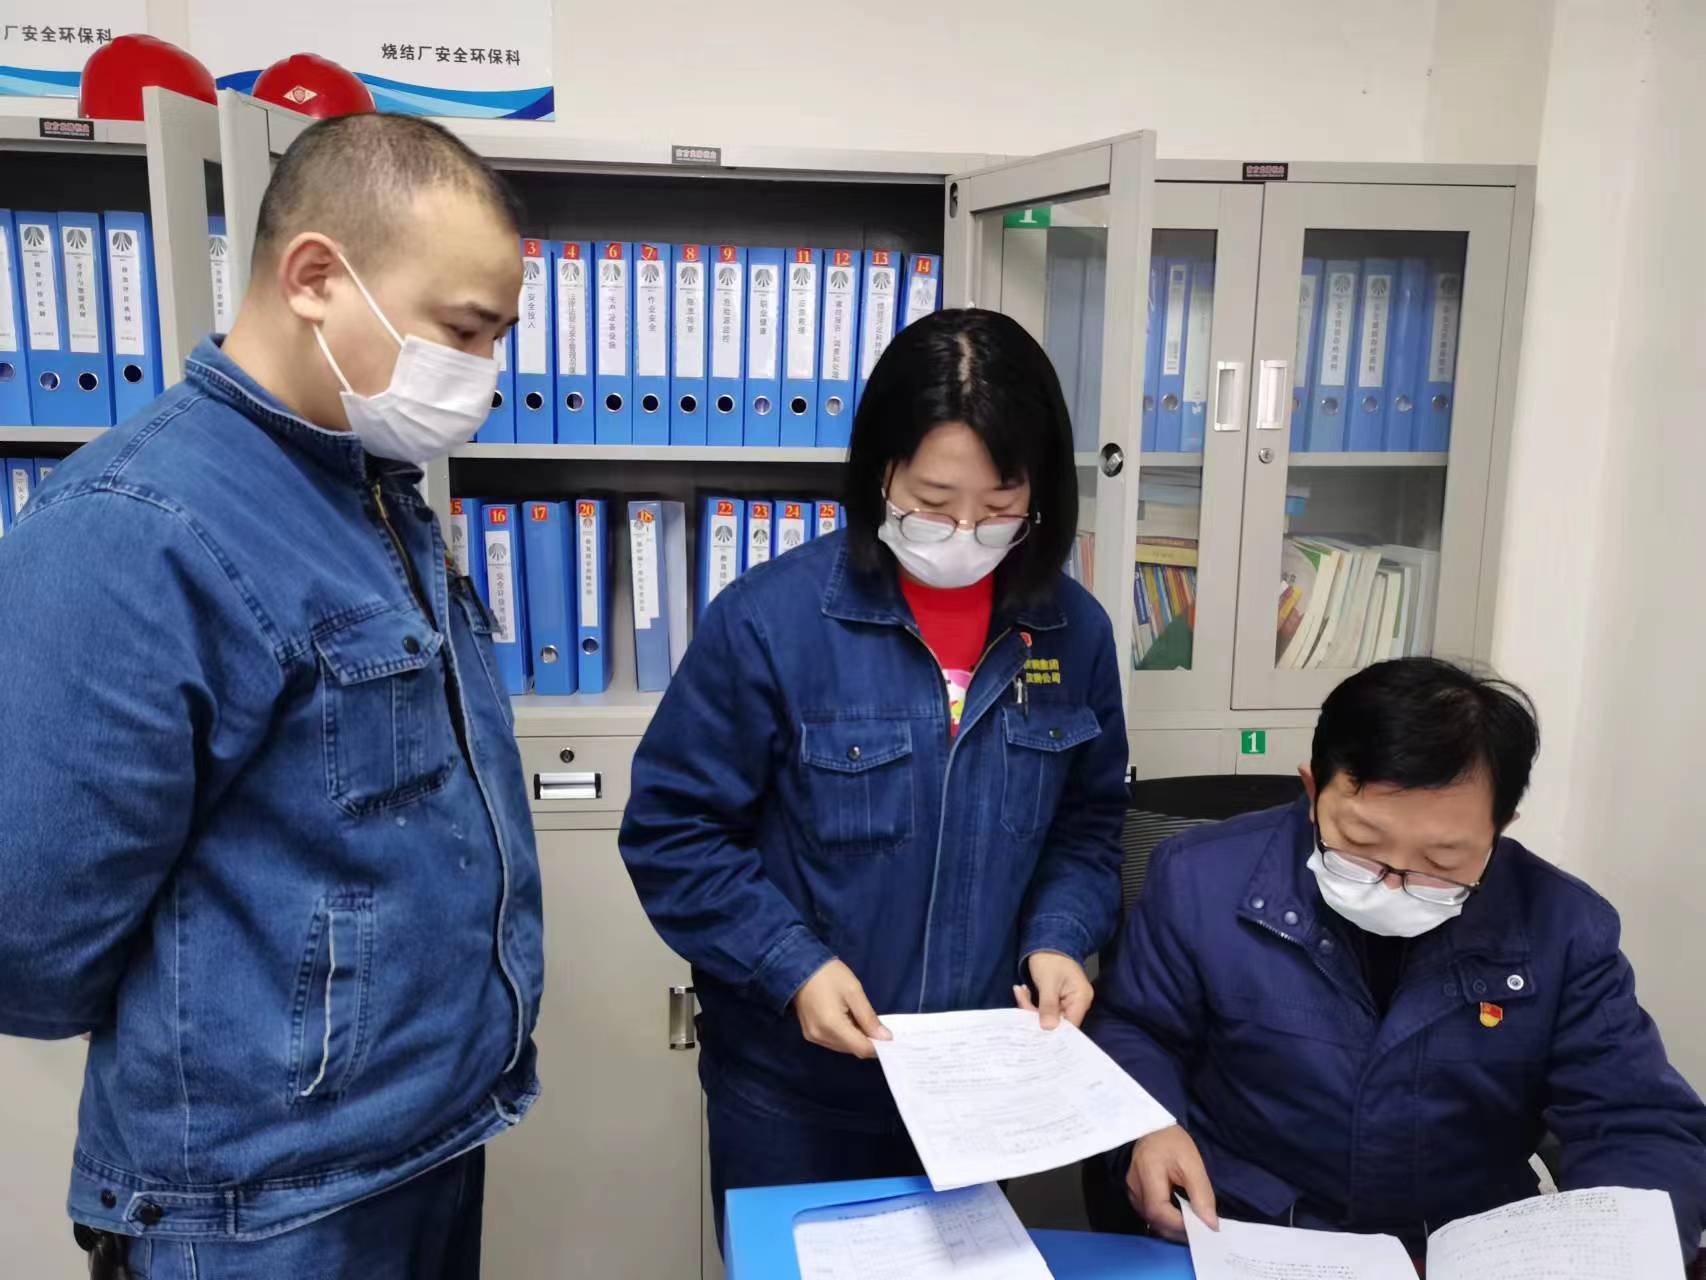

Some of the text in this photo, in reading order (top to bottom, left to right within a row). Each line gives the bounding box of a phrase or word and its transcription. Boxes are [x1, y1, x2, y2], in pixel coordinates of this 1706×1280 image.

[4, 25, 112, 44] 厂安全环保科
[381, 43, 521, 66] 烧结厂安全环保科
[528, 242, 536, 254] 3
[567, 245, 576, 258] 4
[609, 245, 617, 257] 6
[645, 247, 654, 259] 7
[686, 247, 695, 259] 8
[724, 247, 732, 260] 9
[798, 251, 809, 263] 11
[835, 253, 849, 265] 12
[918, 259, 930, 272] 14
[527, 293, 537, 329] 安全投入
[647, 296, 657, 332] 作业安全
[533, 506, 547, 520] 17
[579, 504, 594, 517] 20
[718, 503, 732, 513] 22
[754, 505, 768, 517] 23
[785, 505, 800, 517] 24
[820, 504, 834, 516] 25
[492, 510, 506, 523] 16
[1247, 732, 1260, 752] 1
